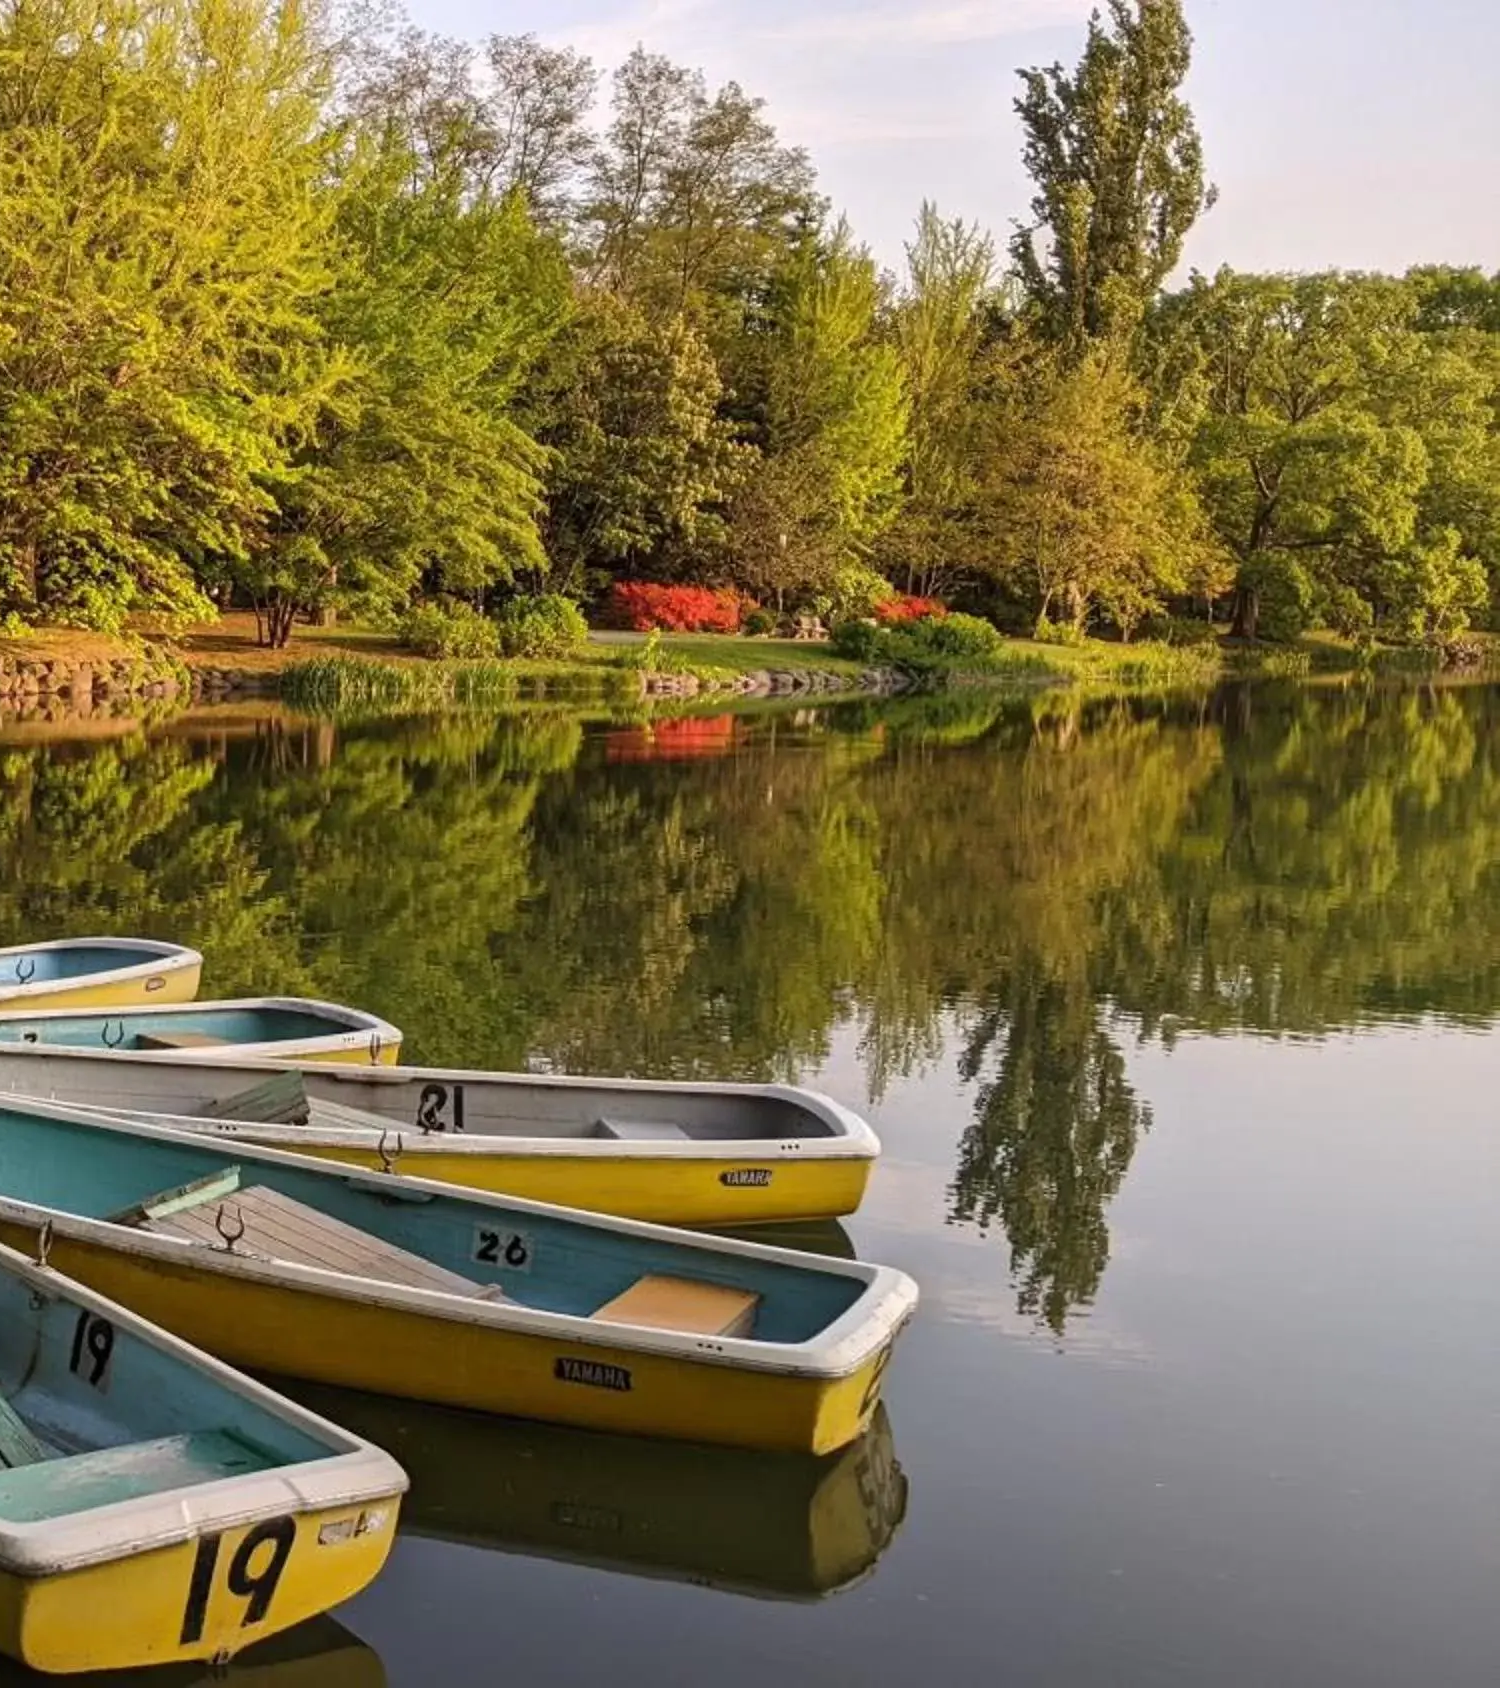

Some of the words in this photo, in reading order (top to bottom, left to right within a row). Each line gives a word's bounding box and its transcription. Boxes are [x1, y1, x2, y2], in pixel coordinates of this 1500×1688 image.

[476, 1231, 527, 1268] 26
[70, 1309, 114, 1387] 19
[562, 1359, 627, 1390] YAMAHA
[179, 1514, 297, 1646] 19
